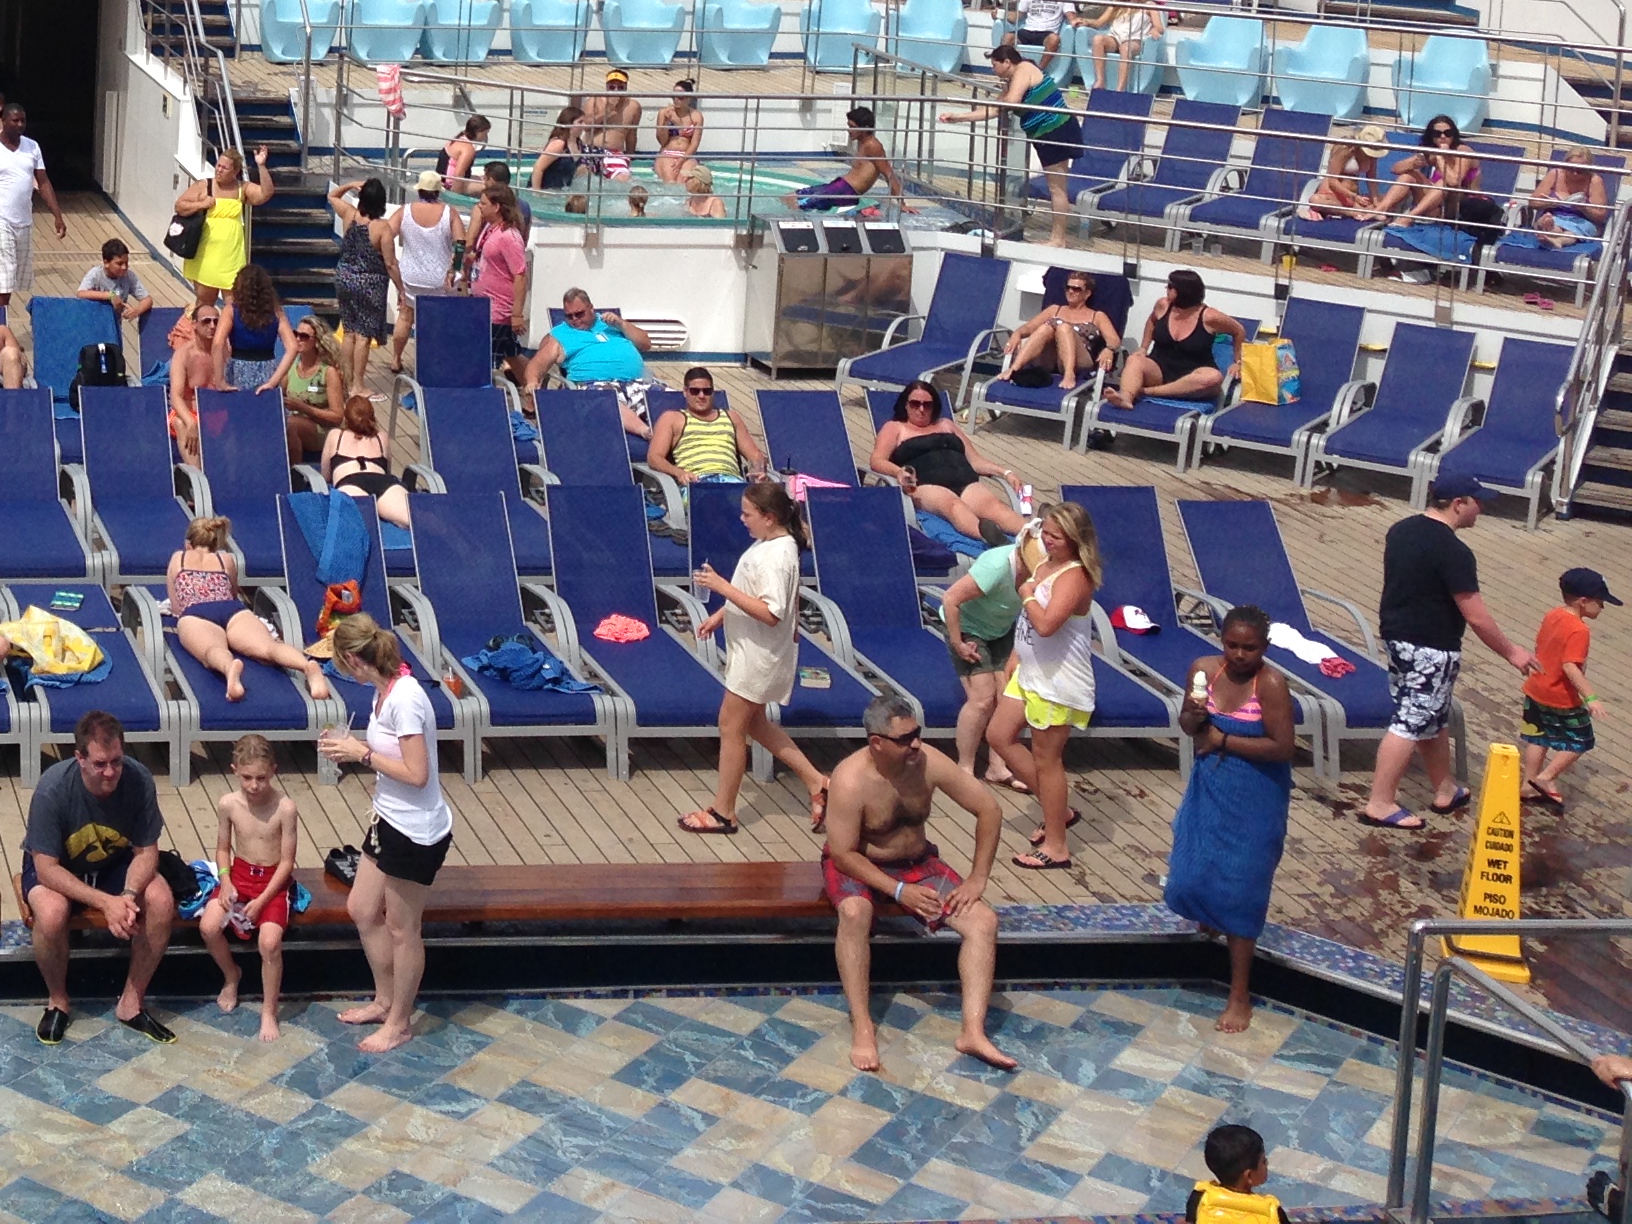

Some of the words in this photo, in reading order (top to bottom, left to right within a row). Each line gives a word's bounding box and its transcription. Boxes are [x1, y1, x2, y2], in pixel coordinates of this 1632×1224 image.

[1487, 827, 1514, 839] CAUTION
[1487, 858, 1509, 870] WET
[1480, 871, 1513, 884] FLOOR
[1484, 892, 1506, 905] PISO
[1474, 905, 1515, 919] MOJADO
